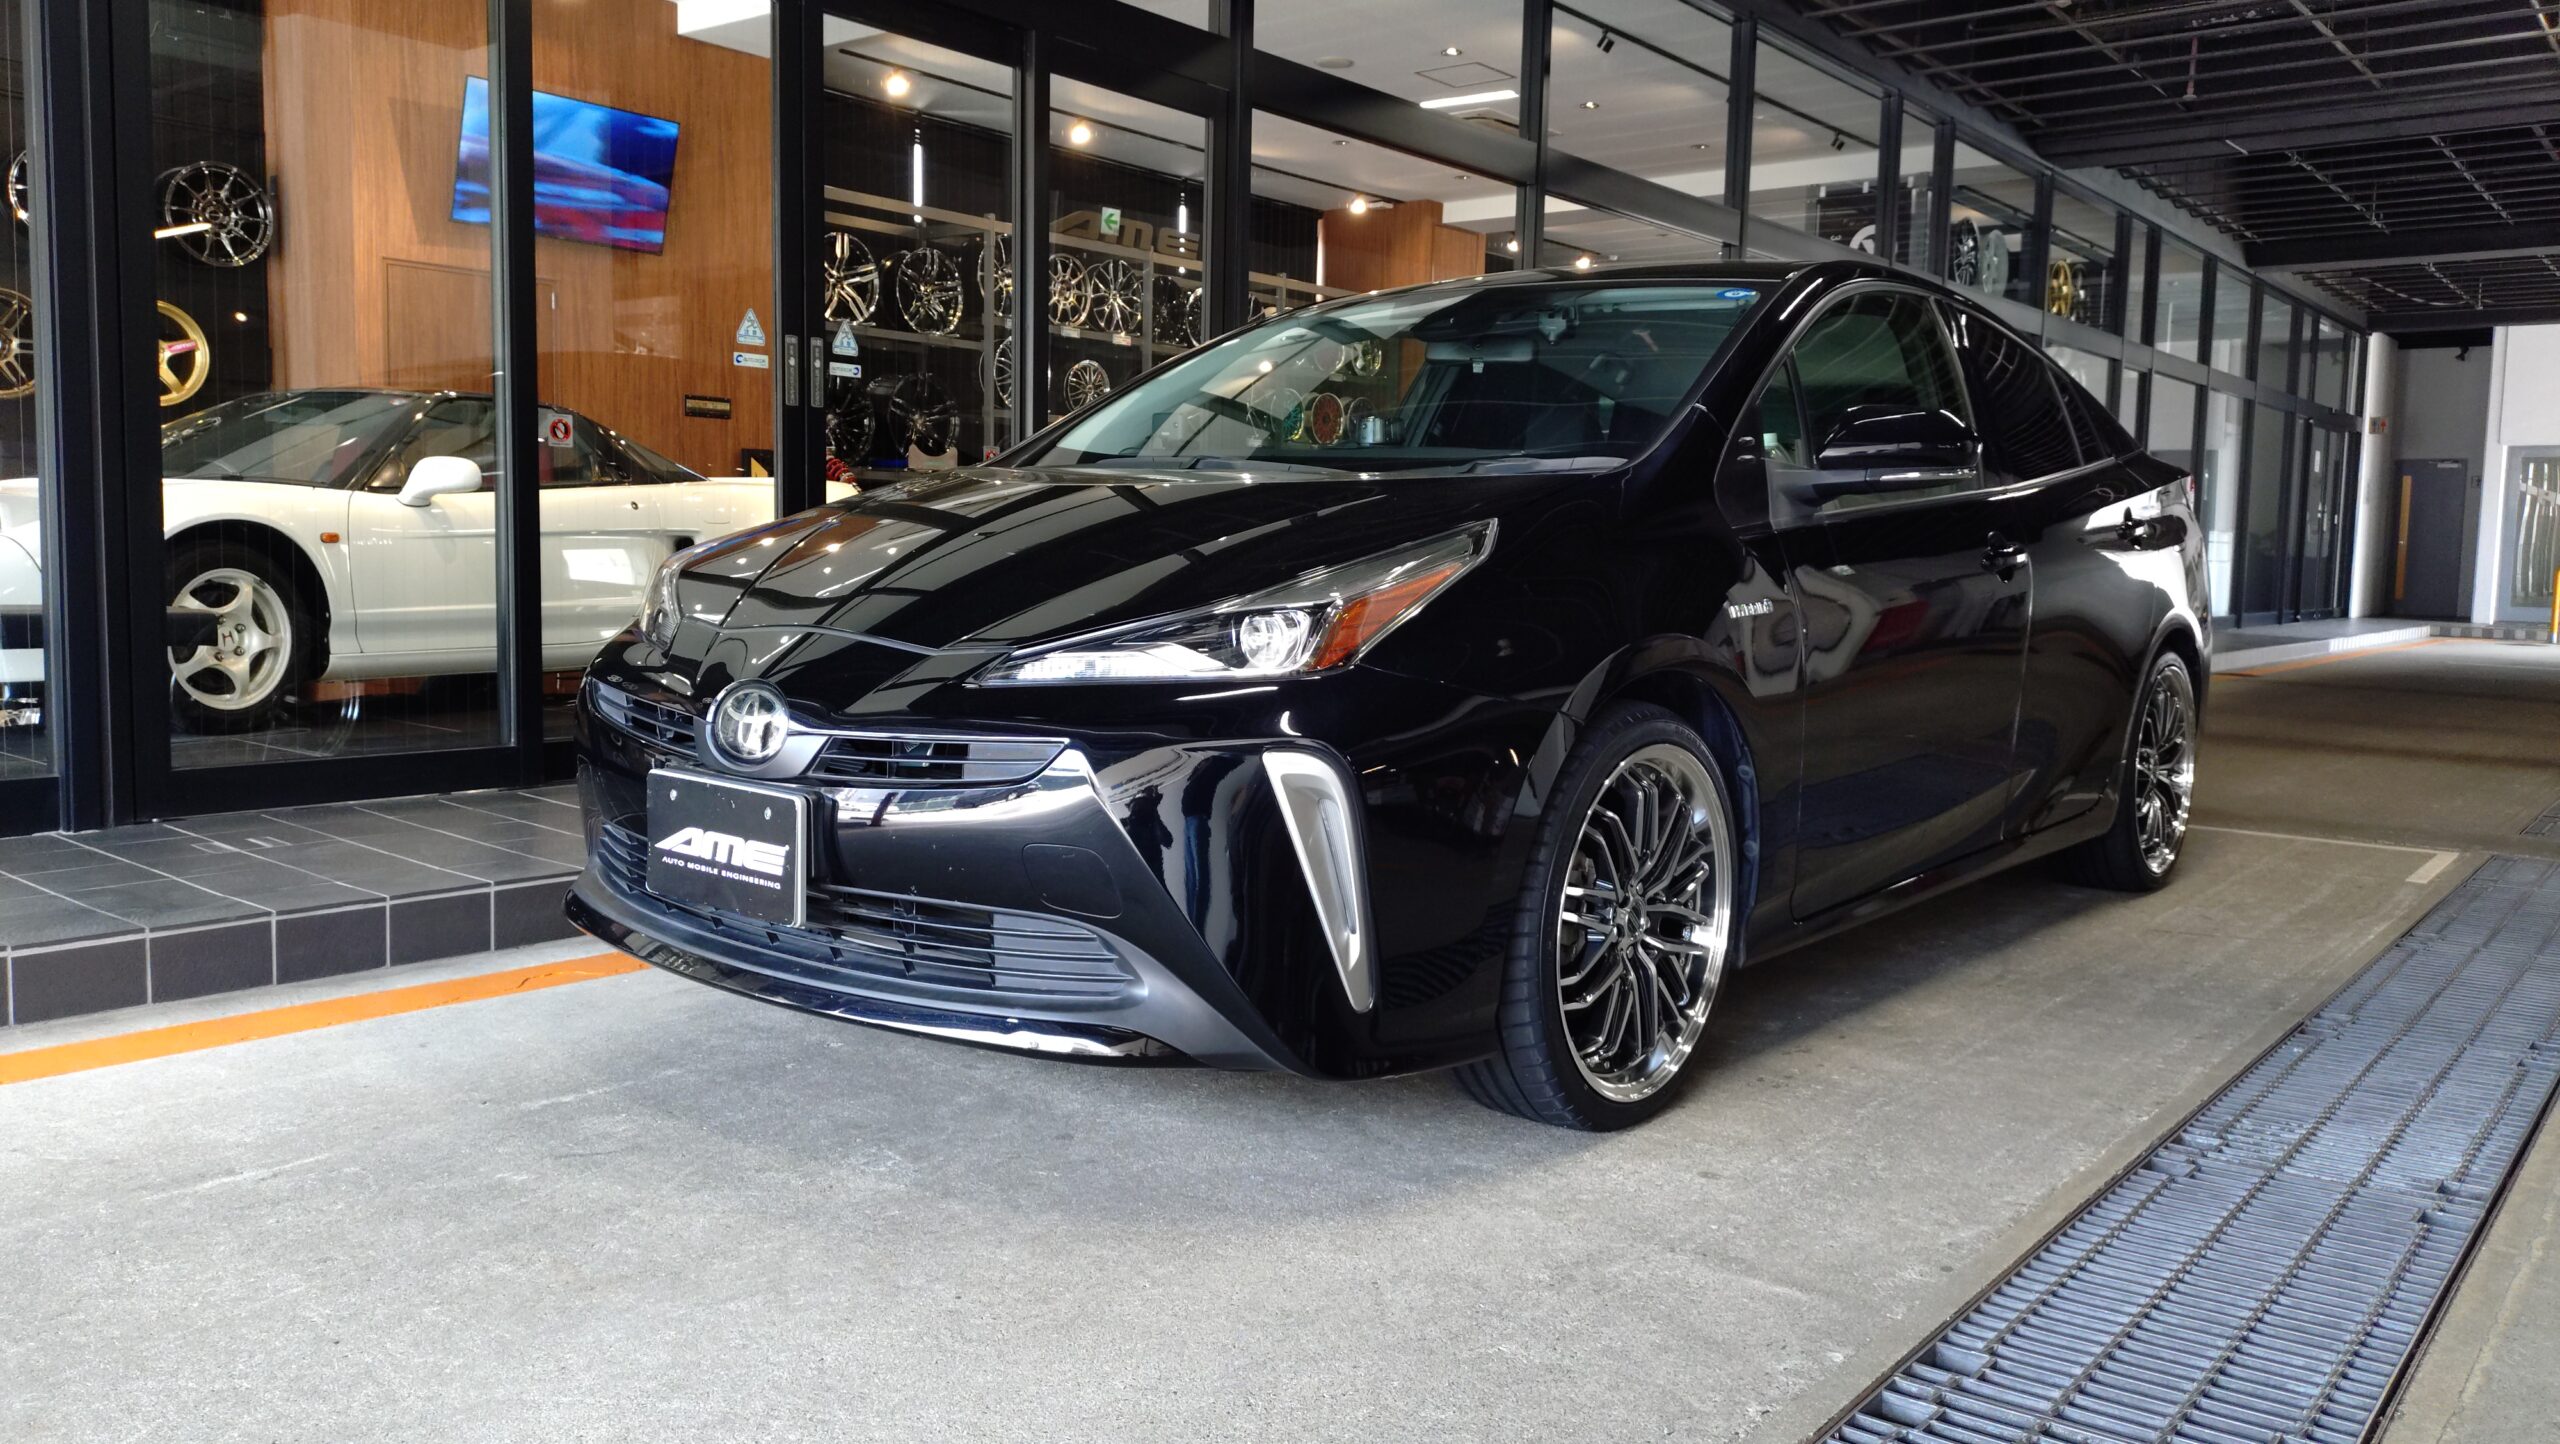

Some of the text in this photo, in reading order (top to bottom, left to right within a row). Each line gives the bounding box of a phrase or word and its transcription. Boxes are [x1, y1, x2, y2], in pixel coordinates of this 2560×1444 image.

[654, 826, 787, 876] AME
[661, 855, 782, 890] AUTO MOBILE ENGINEERING
